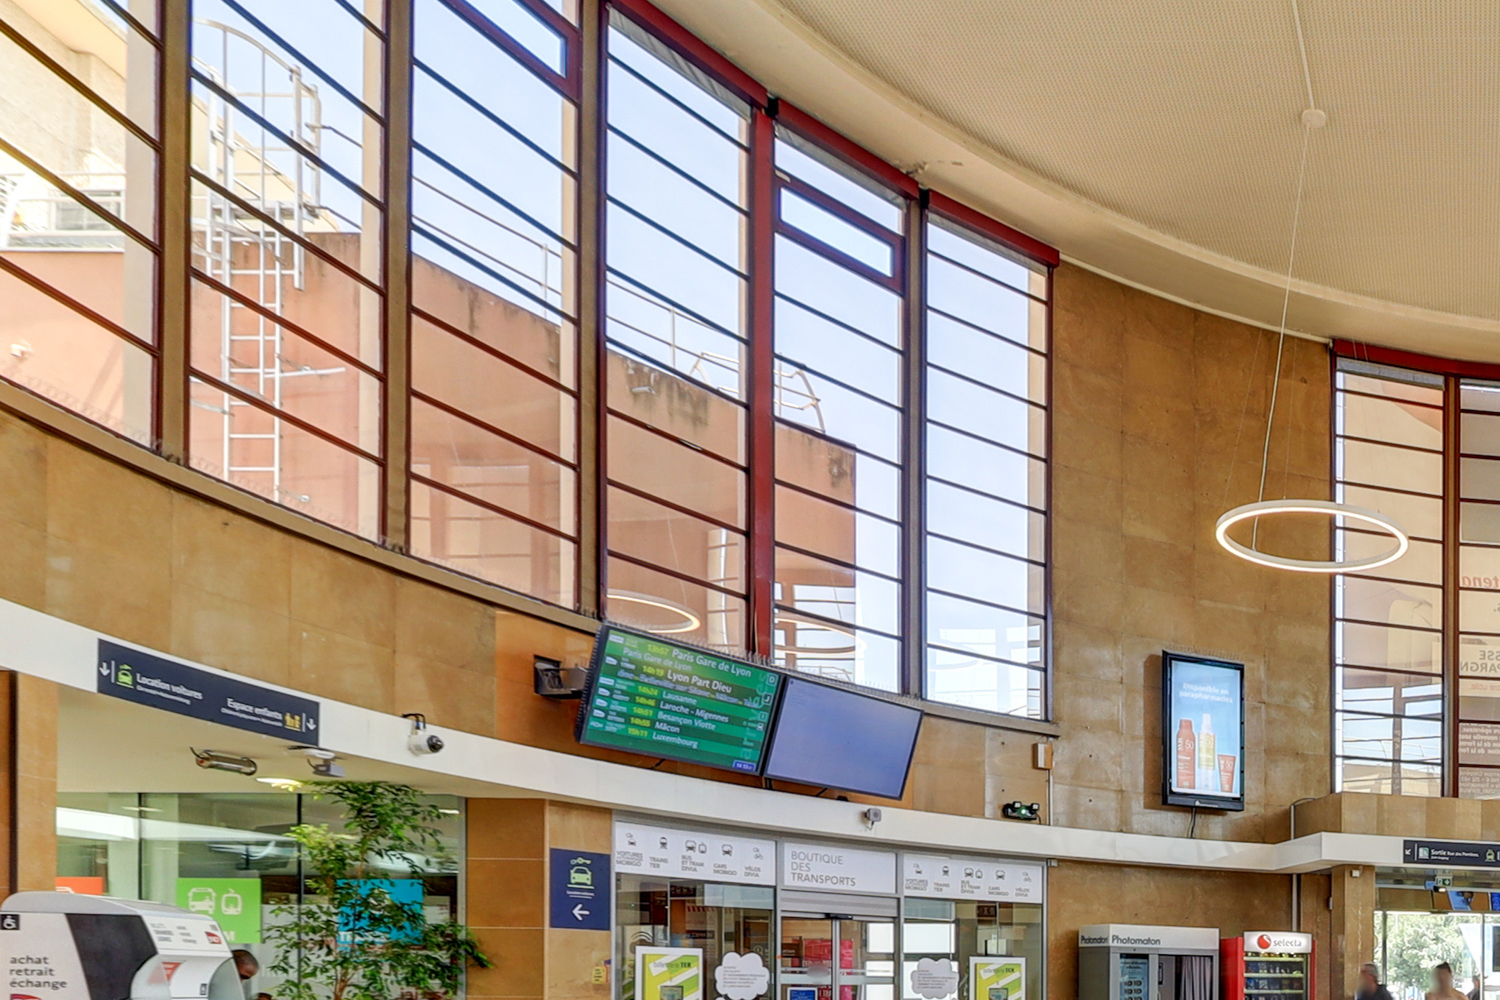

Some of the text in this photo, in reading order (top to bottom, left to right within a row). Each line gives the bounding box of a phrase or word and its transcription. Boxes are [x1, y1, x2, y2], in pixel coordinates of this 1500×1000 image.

[623, 647, 692, 672] Paris Gare de Lyon
[672, 649, 752, 677] Paris Gare de Lyon
[642, 665, 732, 693] 14h19 Lyon Part Dieu
[136, 673, 171, 691] Location
[171, 683, 203, 700] voitures
[1183, 683, 1219, 694] Disponible
[662, 691, 697, 705] Lausanne
[227, 698, 254, 713] Espace
[254, 705, 283, 720] enfants
[660, 701, 729, 723] Laroche Migennes
[654, 721, 680, 733] Mâcon
[657, 711, 716, 730] Besançon Viotte
[652, 732, 699, 749] Luxembourg
[1185, 739, 1194, 750] 50
[791, 851, 844, 865] BOUTIQUE
[791, 862, 811, 872] DES
[791, 872, 856, 887] TRANSPORTS
[1111, 935, 1161, 946] Photomaton
[1273, 939, 1302, 947] selecta
[10, 956, 49, 965] achat
[10, 967, 55, 977] retrait
[10, 979, 67, 991] échange
